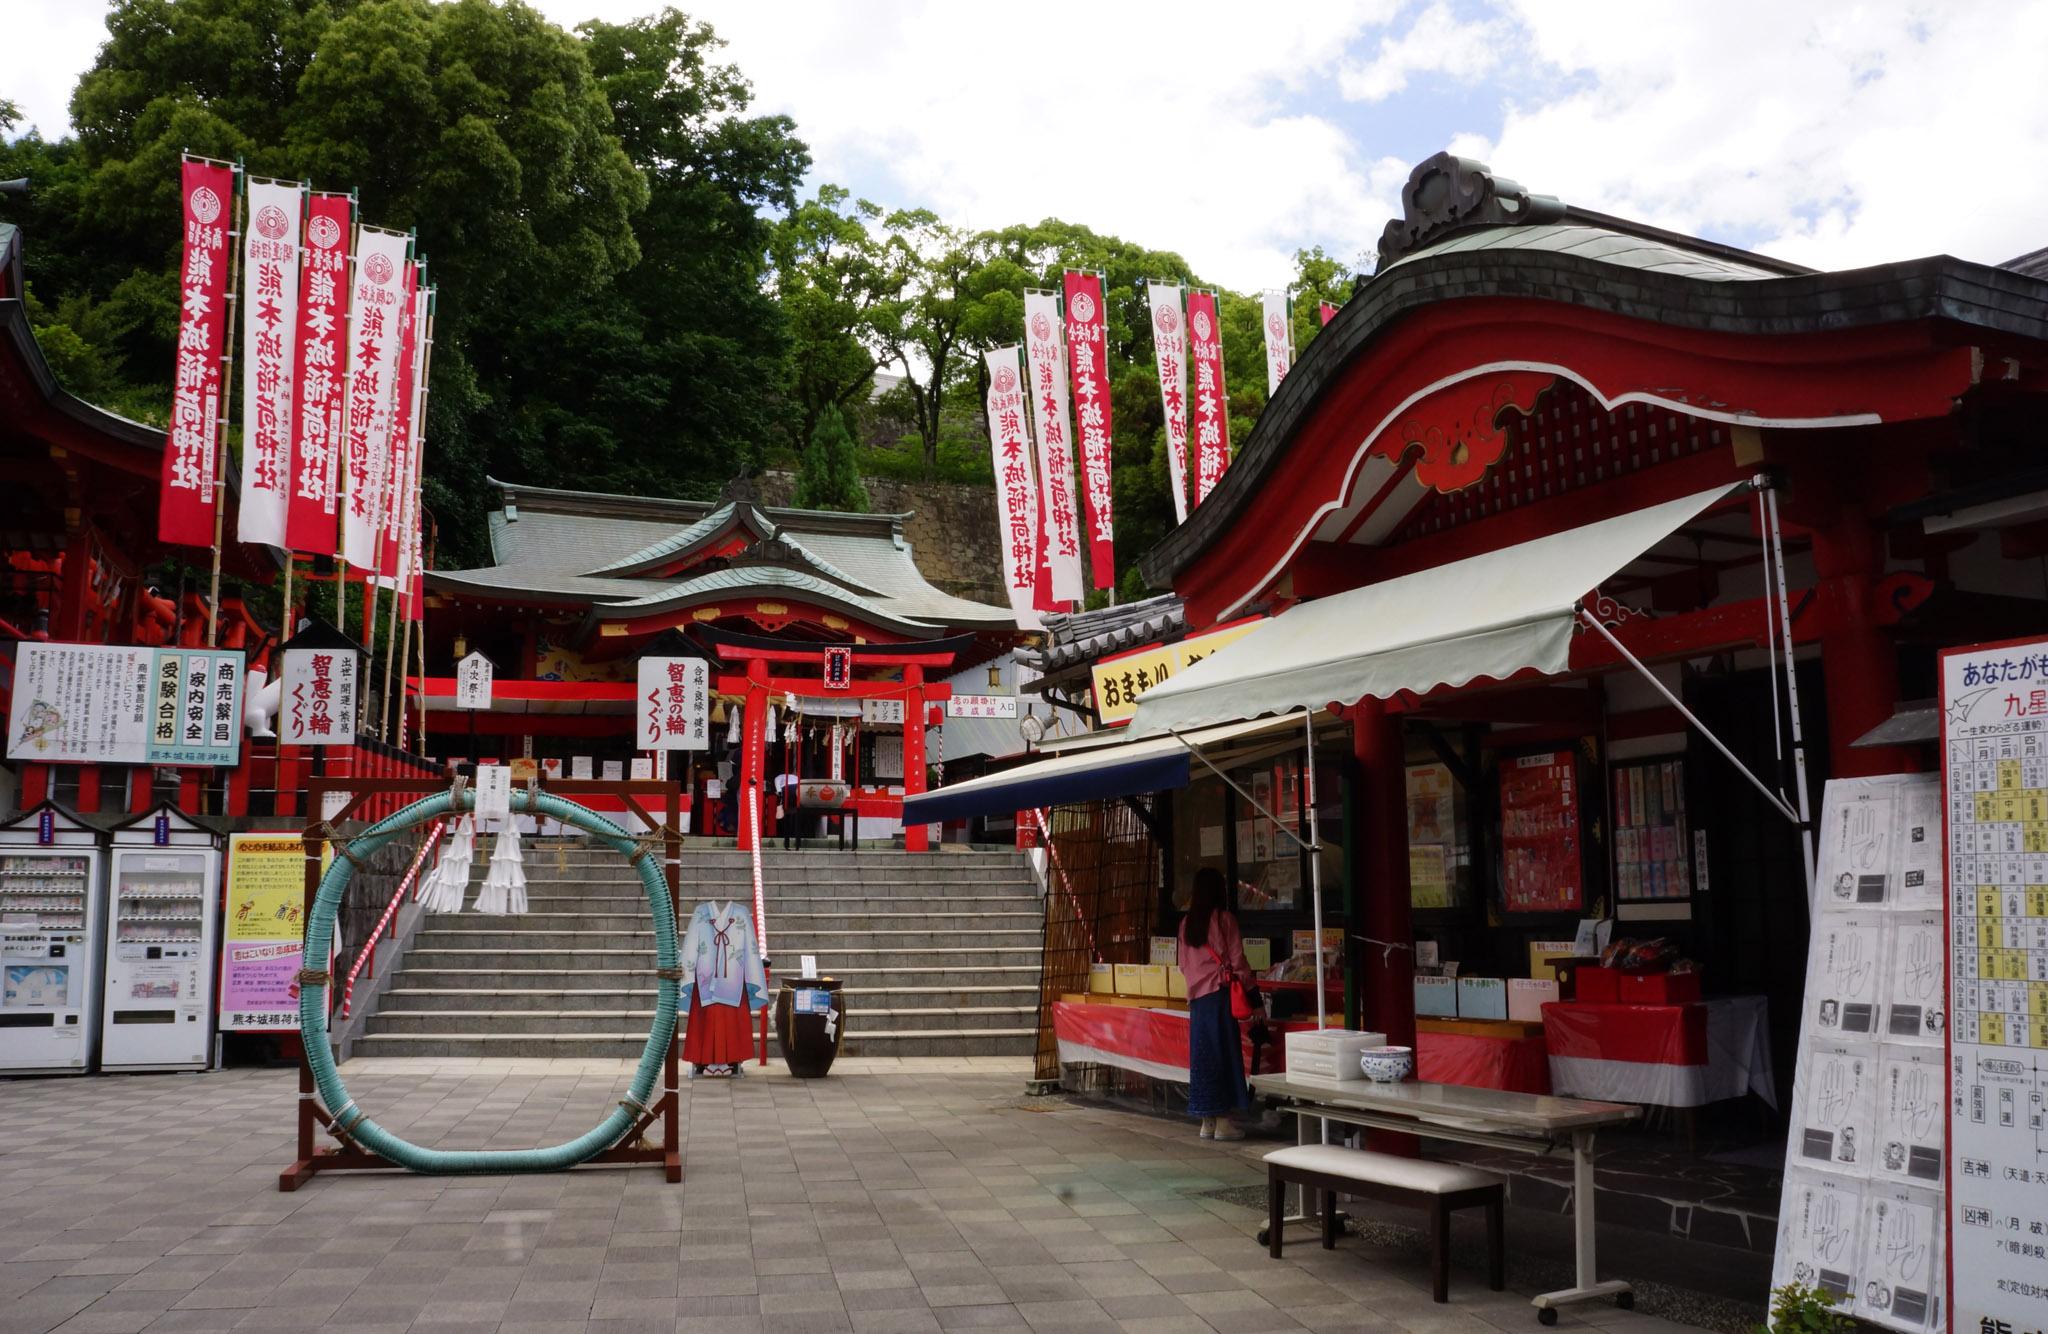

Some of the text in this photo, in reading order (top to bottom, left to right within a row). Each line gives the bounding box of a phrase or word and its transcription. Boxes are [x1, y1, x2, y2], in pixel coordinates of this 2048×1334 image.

[157, 662, 178, 739] 受験合格
[186, 672, 206, 740] 家内安全
[214, 663, 234, 741] 商売繁昌
[310, 653, 334, 736] 智恵の輪
[666, 662, 687, 736] 智恵の輪
[1000, 702, 1014, 711] 入口
[2004, 689, 2048, 717] 九星
[292, 683, 308, 739] くぐり
[648, 688, 662, 743] くぐり
[150, 751, 231, 762] 熊本城稲荷神社
[1978, 740, 1989, 759] 二月
[2001, 738, 2011, 757] 三月
[2024, 736, 2036, 755] 四月
[1963, 1161, 1989, 1177] 吉神
[1964, 1207, 1989, 1225] 凶神
